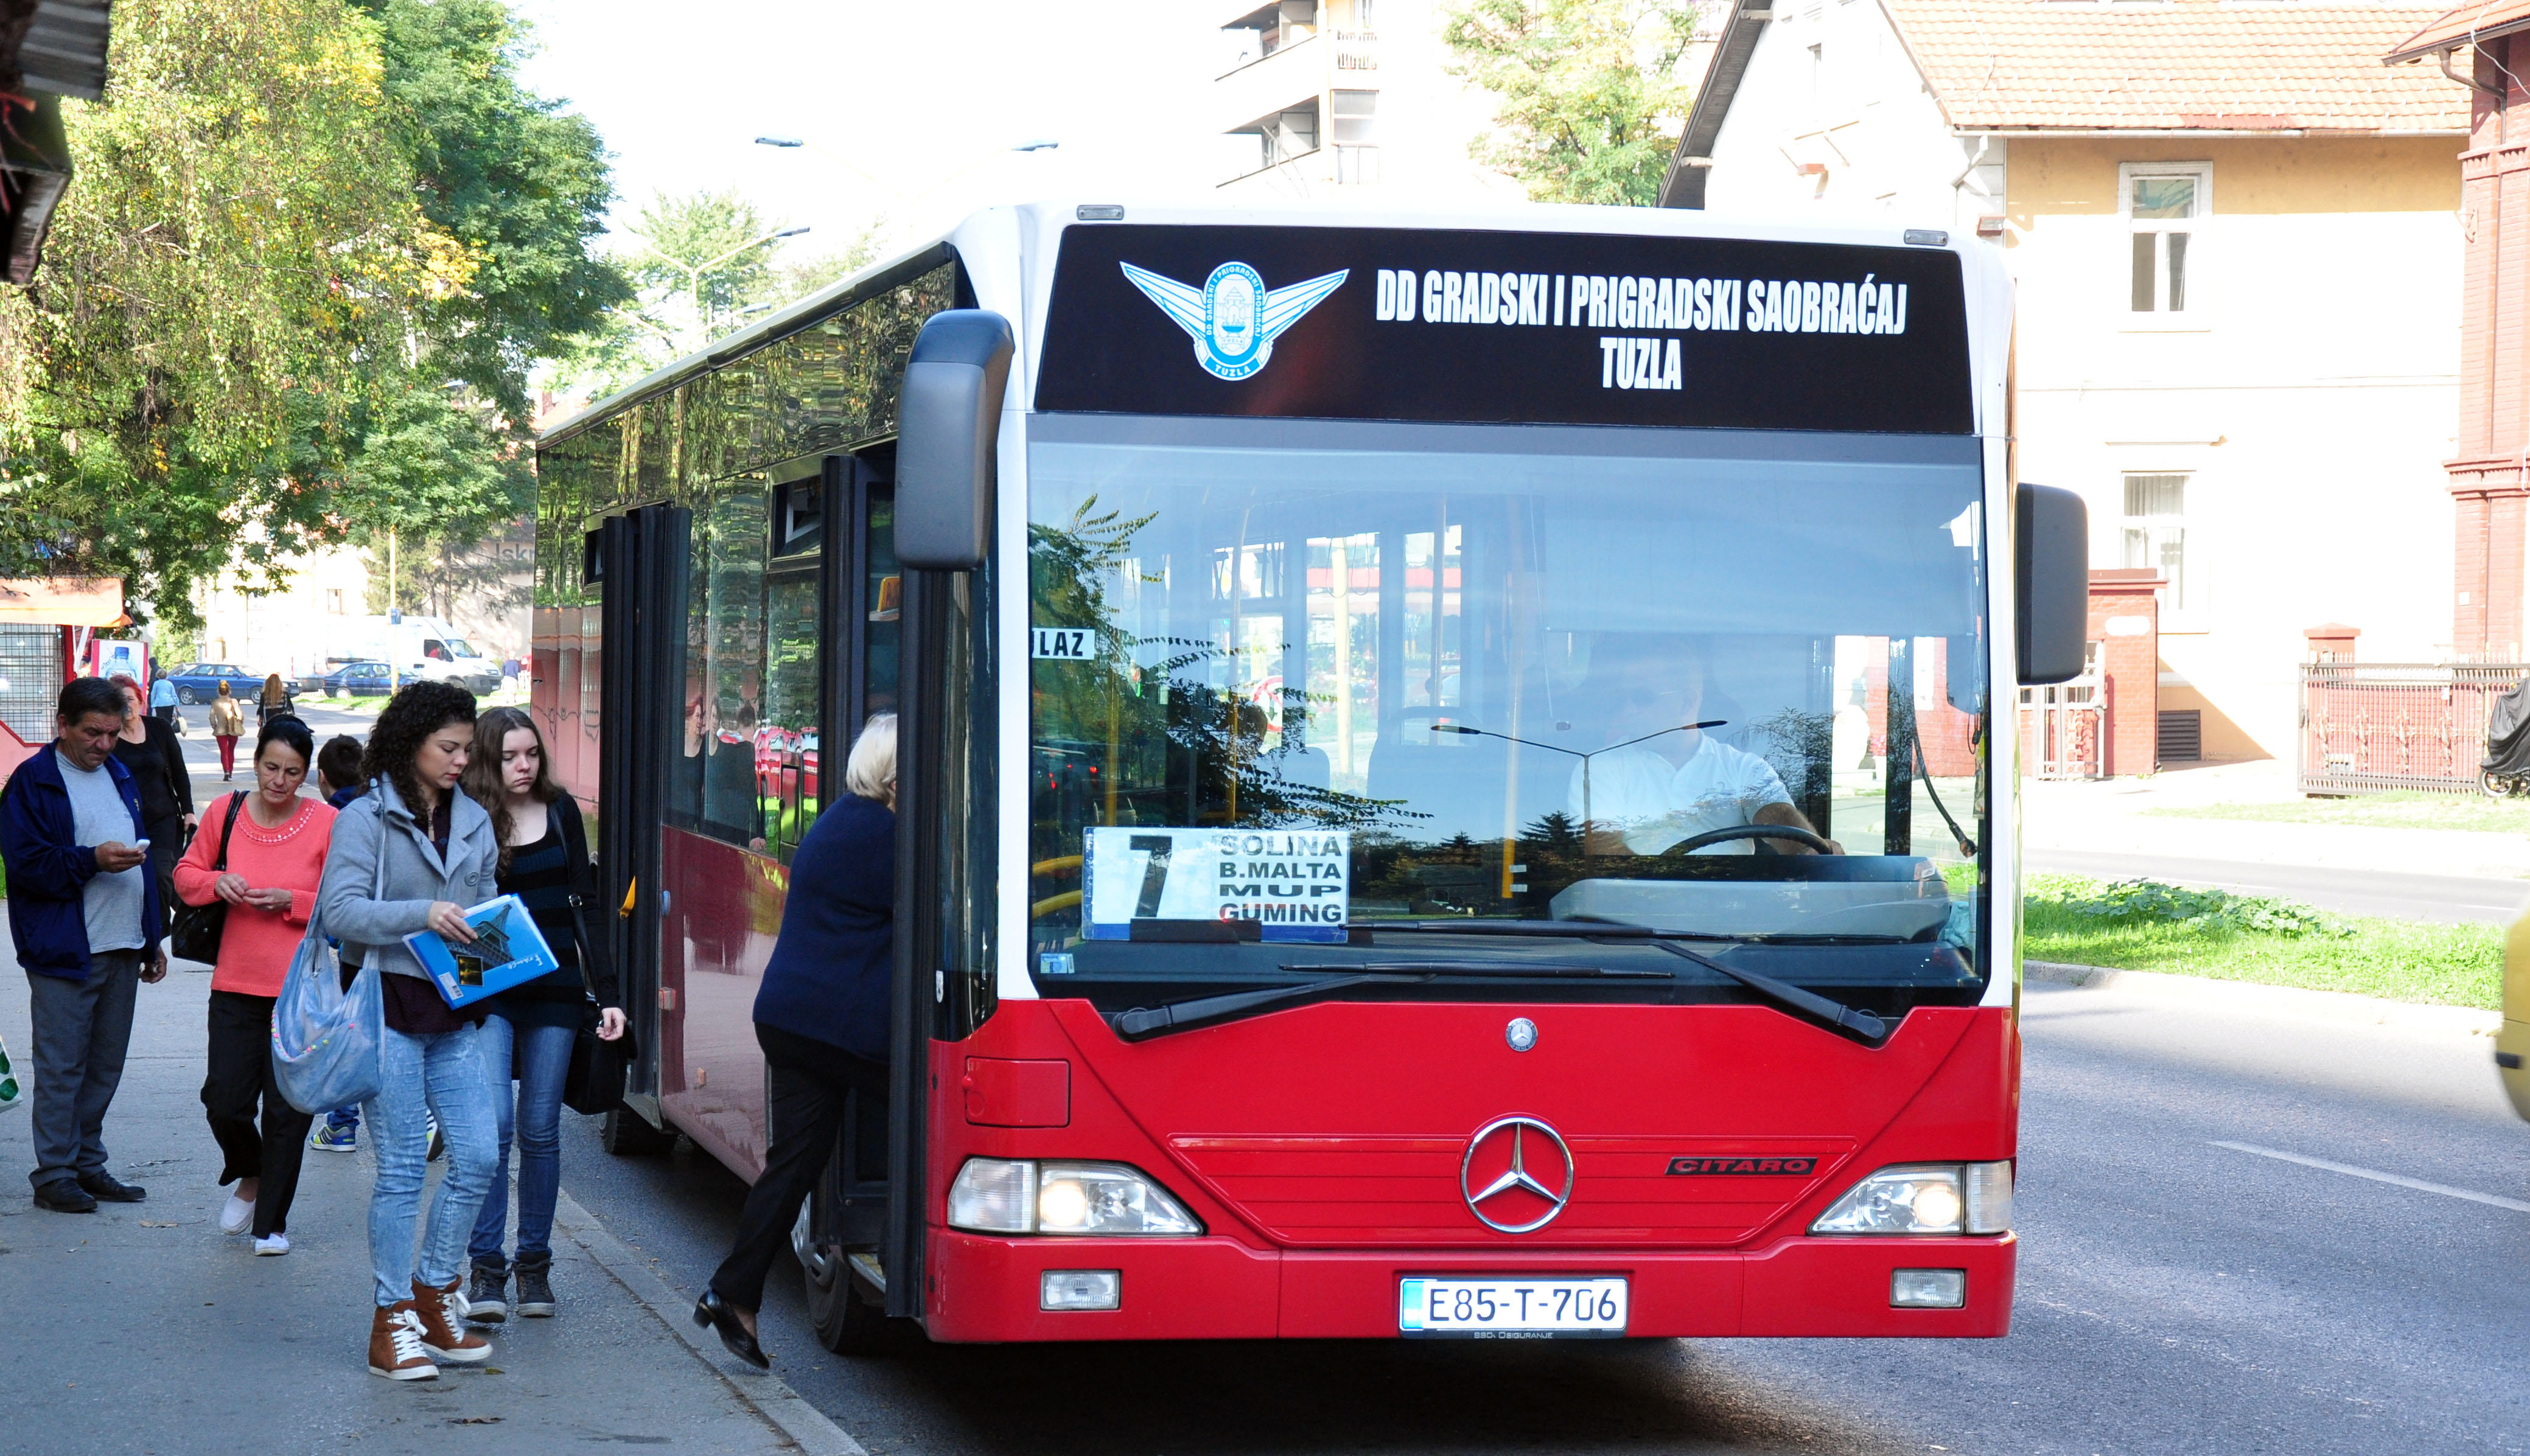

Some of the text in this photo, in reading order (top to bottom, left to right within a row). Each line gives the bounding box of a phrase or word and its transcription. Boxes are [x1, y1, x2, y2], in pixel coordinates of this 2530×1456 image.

[1217, 266, 1260, 288] PRIGRADSKI
[1376, 269, 1907, 335] DD GRADSKI I PRIGRADSKI SAOBRAĆAJ
[1215, 364, 1251, 377] TUZLA
[1599, 336, 1682, 390] TUZLA
[1219, 835, 1343, 857] SOLINA
[1130, 834, 1173, 918] 7
[1219, 862, 1342, 879] B.MALTA
[1219, 884, 1343, 897] MUP
[1219, 903, 1343, 923] GUMING
[1674, 1160, 1809, 1172] CITARO
[1429, 1288, 1617, 1322] E85-T-706
